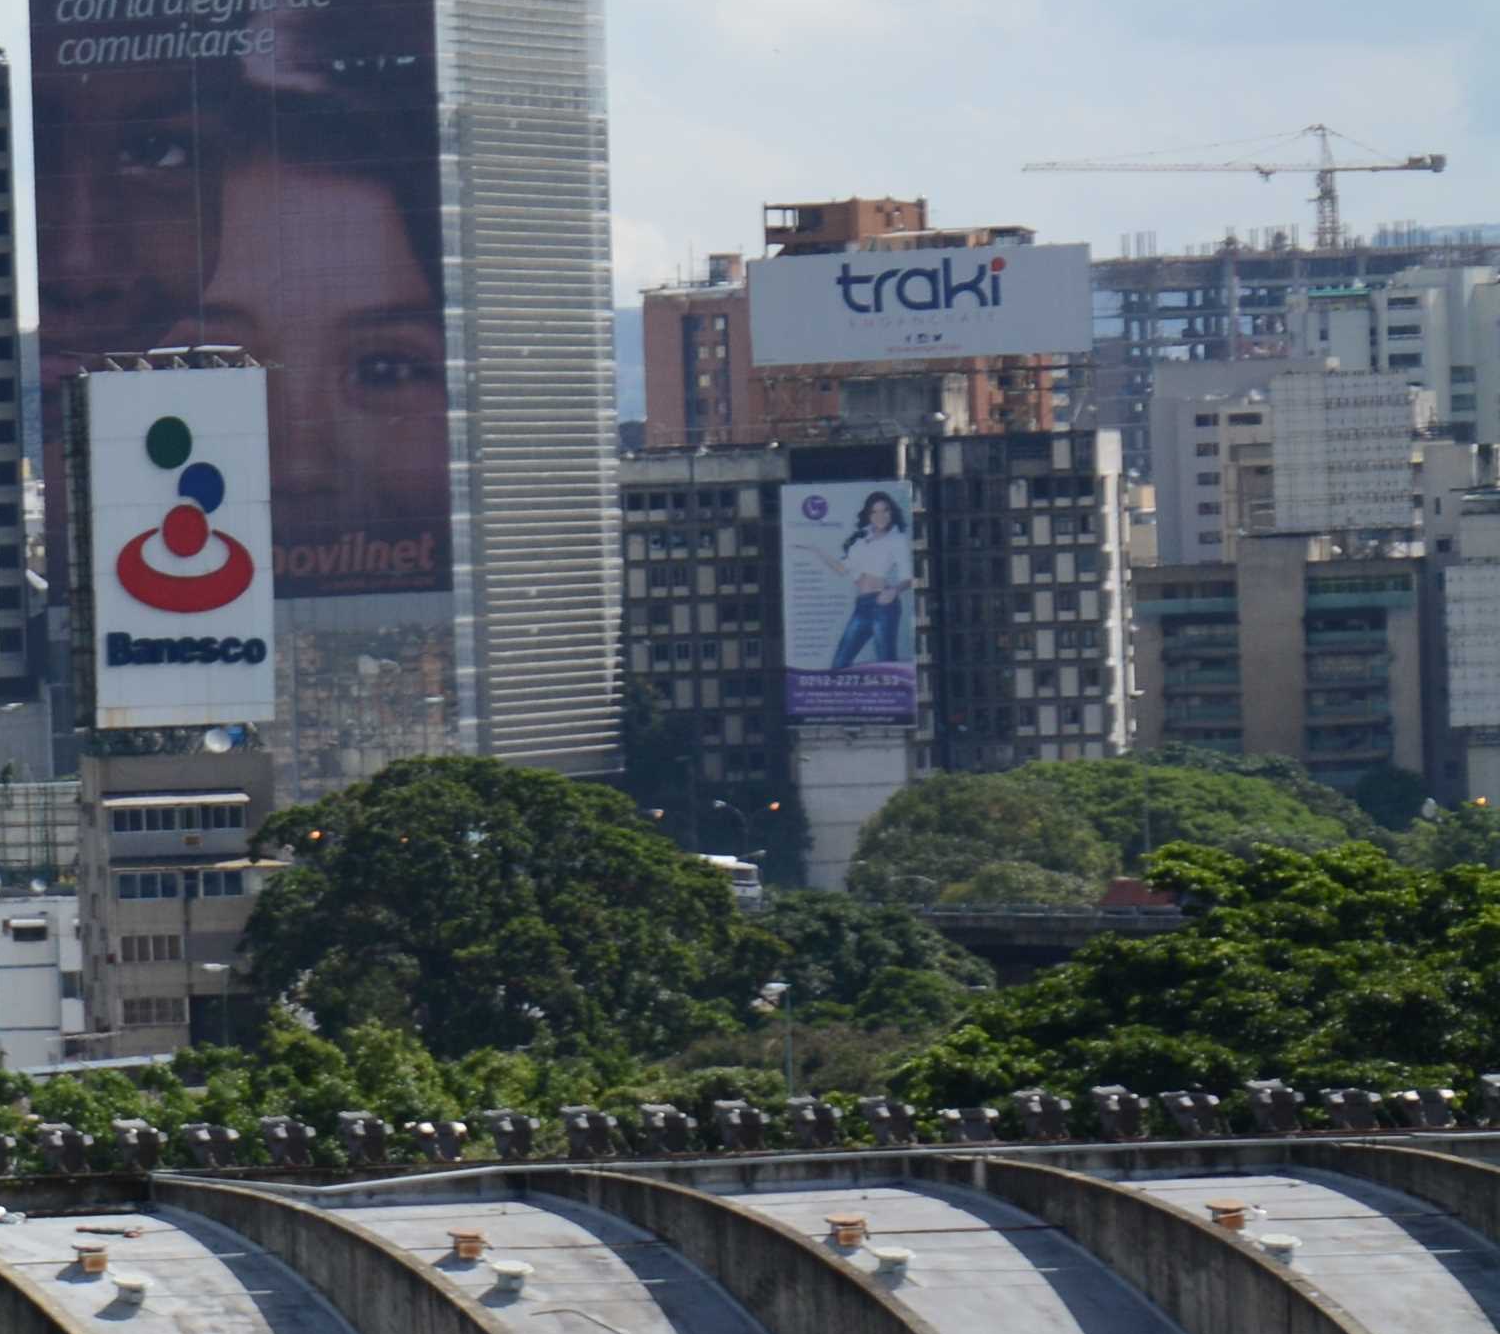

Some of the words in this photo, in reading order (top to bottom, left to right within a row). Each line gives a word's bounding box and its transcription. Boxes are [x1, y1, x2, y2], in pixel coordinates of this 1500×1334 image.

[58, 22, 276, 66] comunicarse
[836, 257, 1007, 313] traki
[106, 631, 267, 667] Banesco
